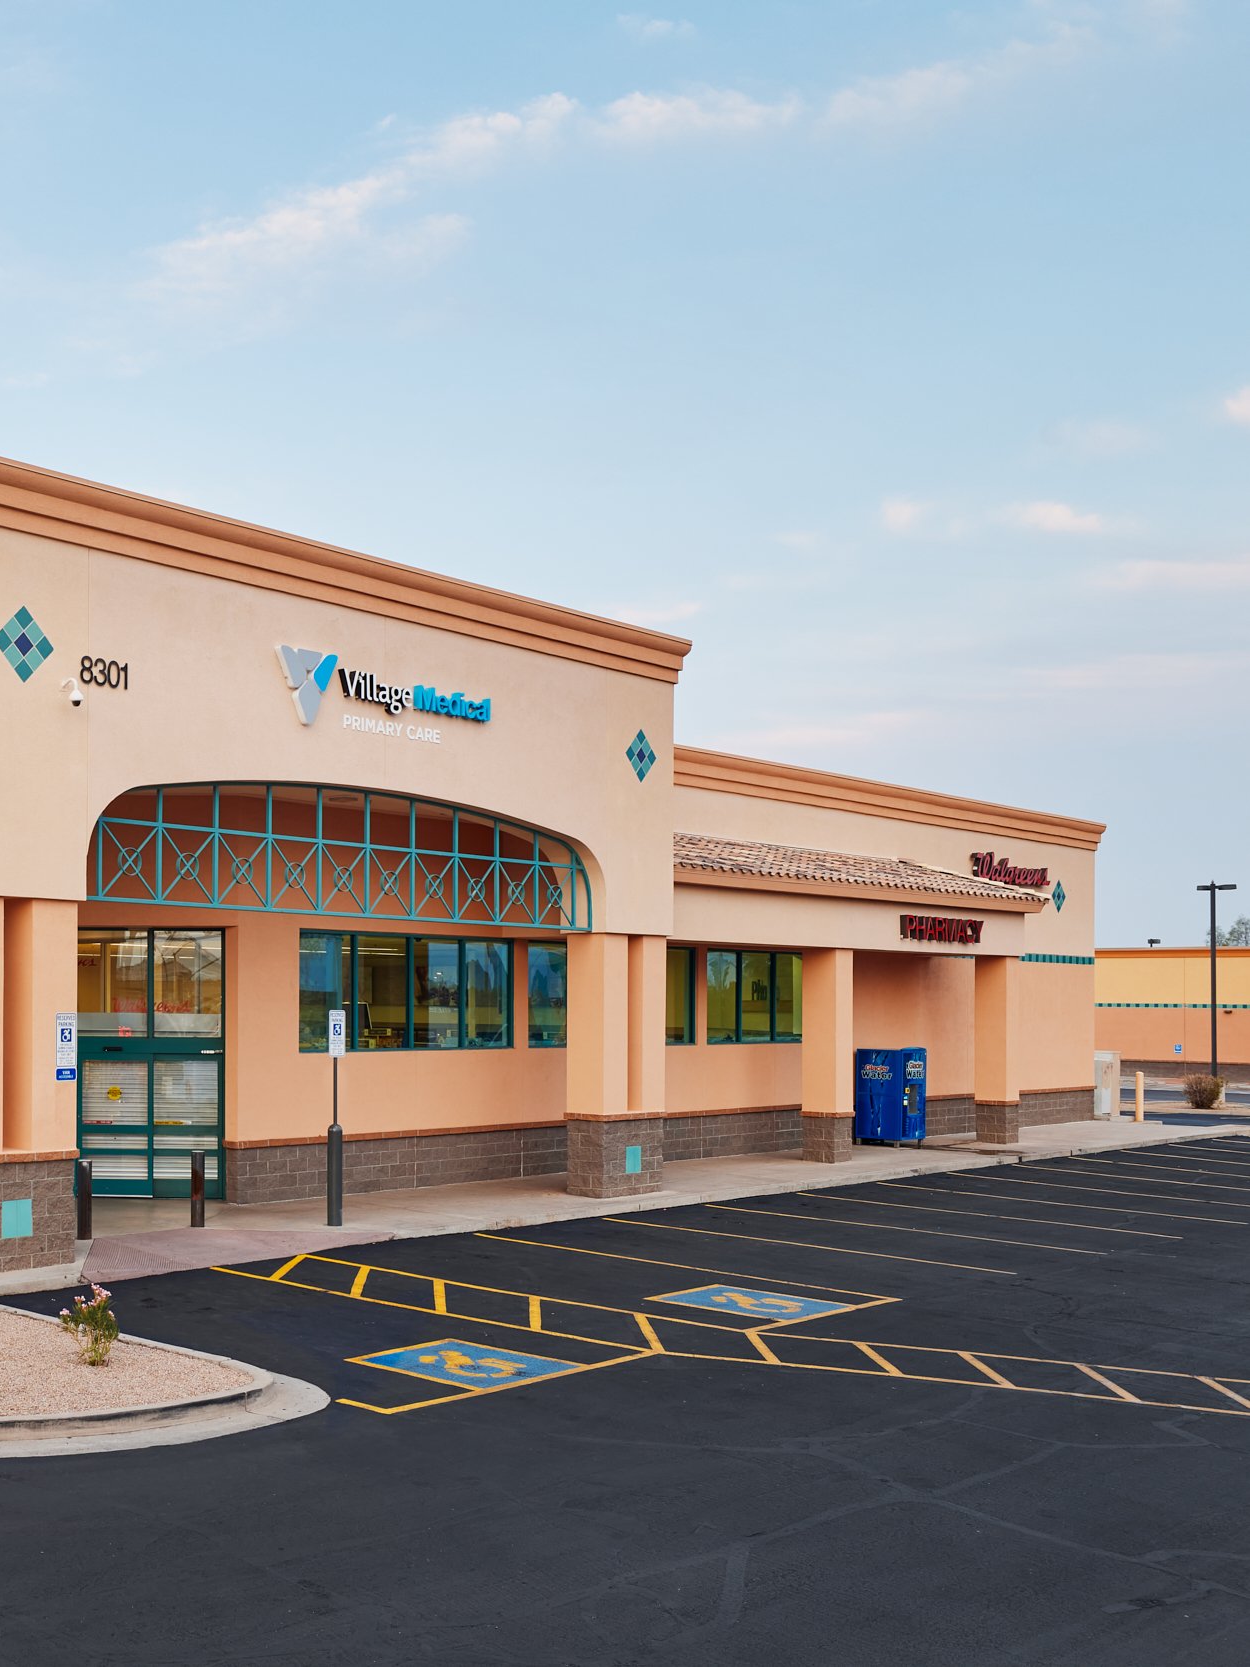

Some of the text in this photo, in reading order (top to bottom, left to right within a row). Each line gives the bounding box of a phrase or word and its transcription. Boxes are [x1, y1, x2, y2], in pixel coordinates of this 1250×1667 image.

[80, 655, 128, 690] 8301
[343, 714, 441, 744] PRIMARY CARE
[970, 852, 1051, 886] Walgreens
[903, 915, 984, 943] PHARMACY
[861, 1070, 892, 1080] Water
